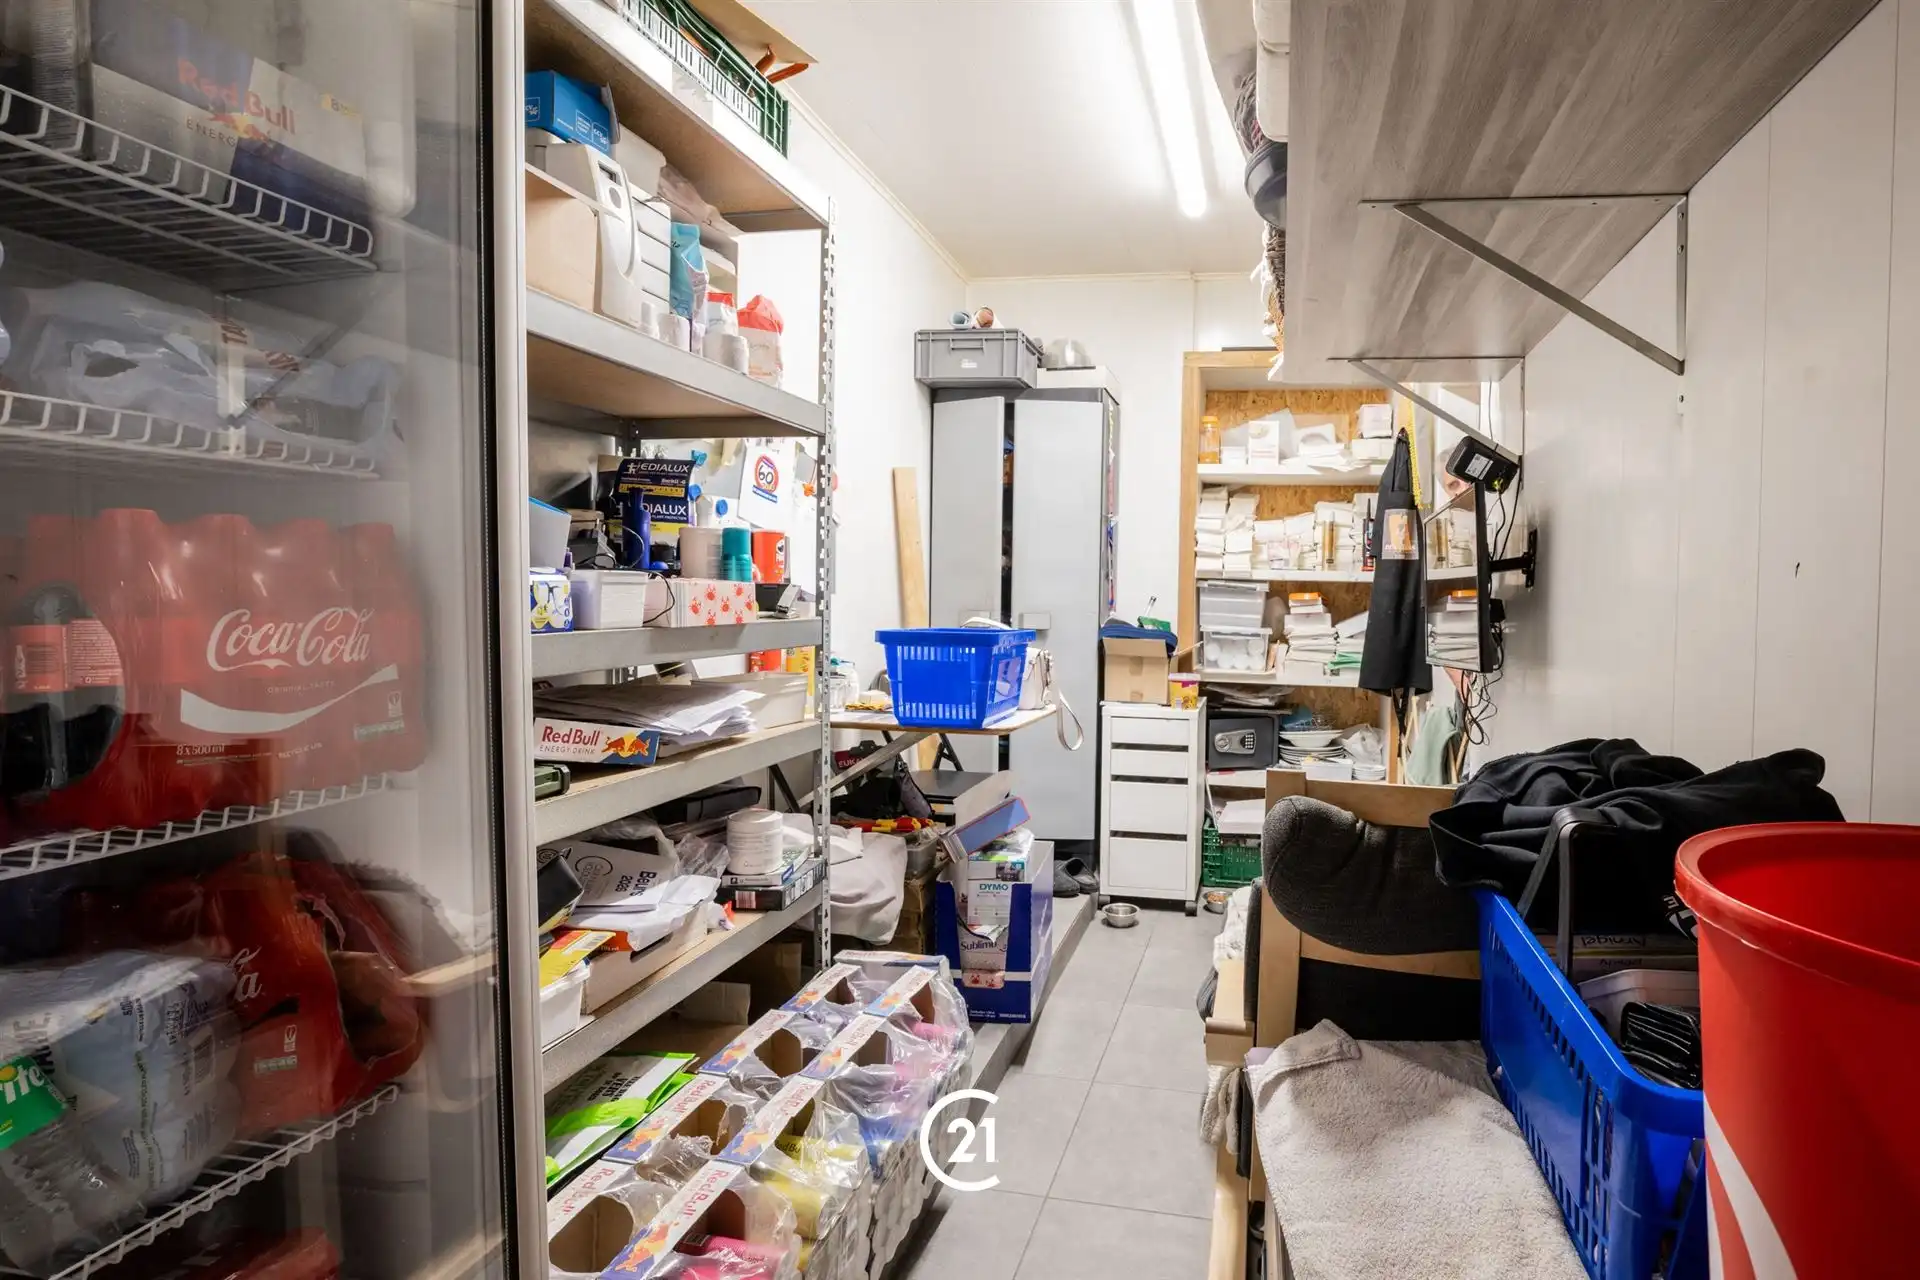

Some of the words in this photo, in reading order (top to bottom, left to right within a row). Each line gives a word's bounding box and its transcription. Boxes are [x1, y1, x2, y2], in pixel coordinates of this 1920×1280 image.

[245, 90, 296, 136] Bull
[185, 117, 236, 147] ENERG
[640, 462, 690, 474] EDIALUX
[758, 464, 774, 485] 60
[641, 502, 687, 516] DIALUX
[206, 606, 376, 672] Coca-Cola
[541, 725, 573, 744] Red
[571, 728, 601, 747] Bull
[539, 744, 570, 754] ENERGY
[572, 746, 596, 755] DRINK
[979, 883, 1009, 891] DYMO
[0, 1065, 45, 1105] ite
[582, 1167, 615, 1191] Red
[701, 1169, 729, 1194] Red
[683, 1191, 709, 1219] Bull
